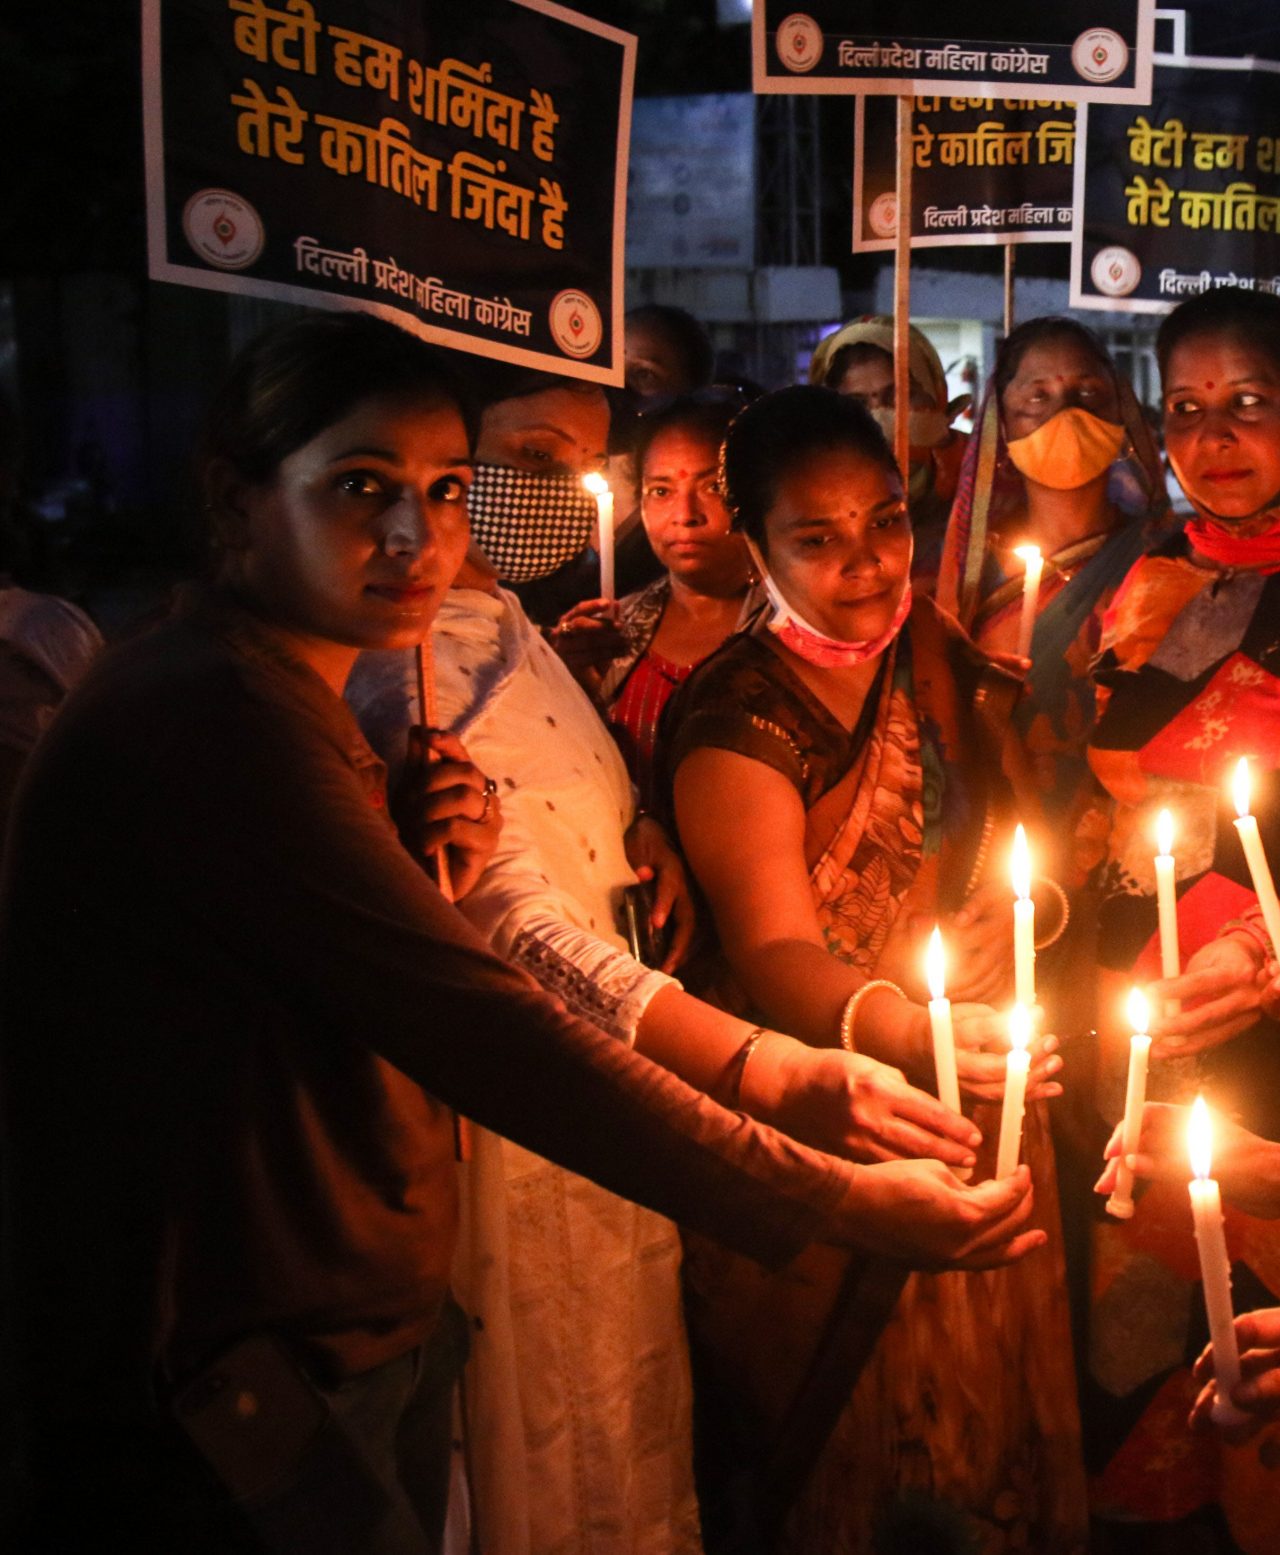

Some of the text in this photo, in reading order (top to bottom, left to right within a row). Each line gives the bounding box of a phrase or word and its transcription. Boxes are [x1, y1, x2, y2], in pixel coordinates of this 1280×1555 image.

[228, 0, 560, 162] बेटी हम शर्मिंदा है
[925, 44, 988, 71] महिला
[990, 48, 1049, 74] कांग्रेस
[231, 78, 568, 250] तेरे कातिल जिंदा है
[938, 121, 1032, 166] कातिल
[1127, 115, 1187, 169] बेटी
[1191, 132, 1249, 172] हम
[923, 204, 968, 228] दिल्ली
[970, 204, 1005, 226] प्रदेश
[1008, 203, 1053, 225] महिला
[1124, 175, 1175, 228] तेरे
[293, 235, 369, 285] दिल्ली
[373, 256, 414, 299] प्रदेश
[474, 295, 532, 336] कांग्रेस
[1159, 268, 1212, 294] दिल्ली
